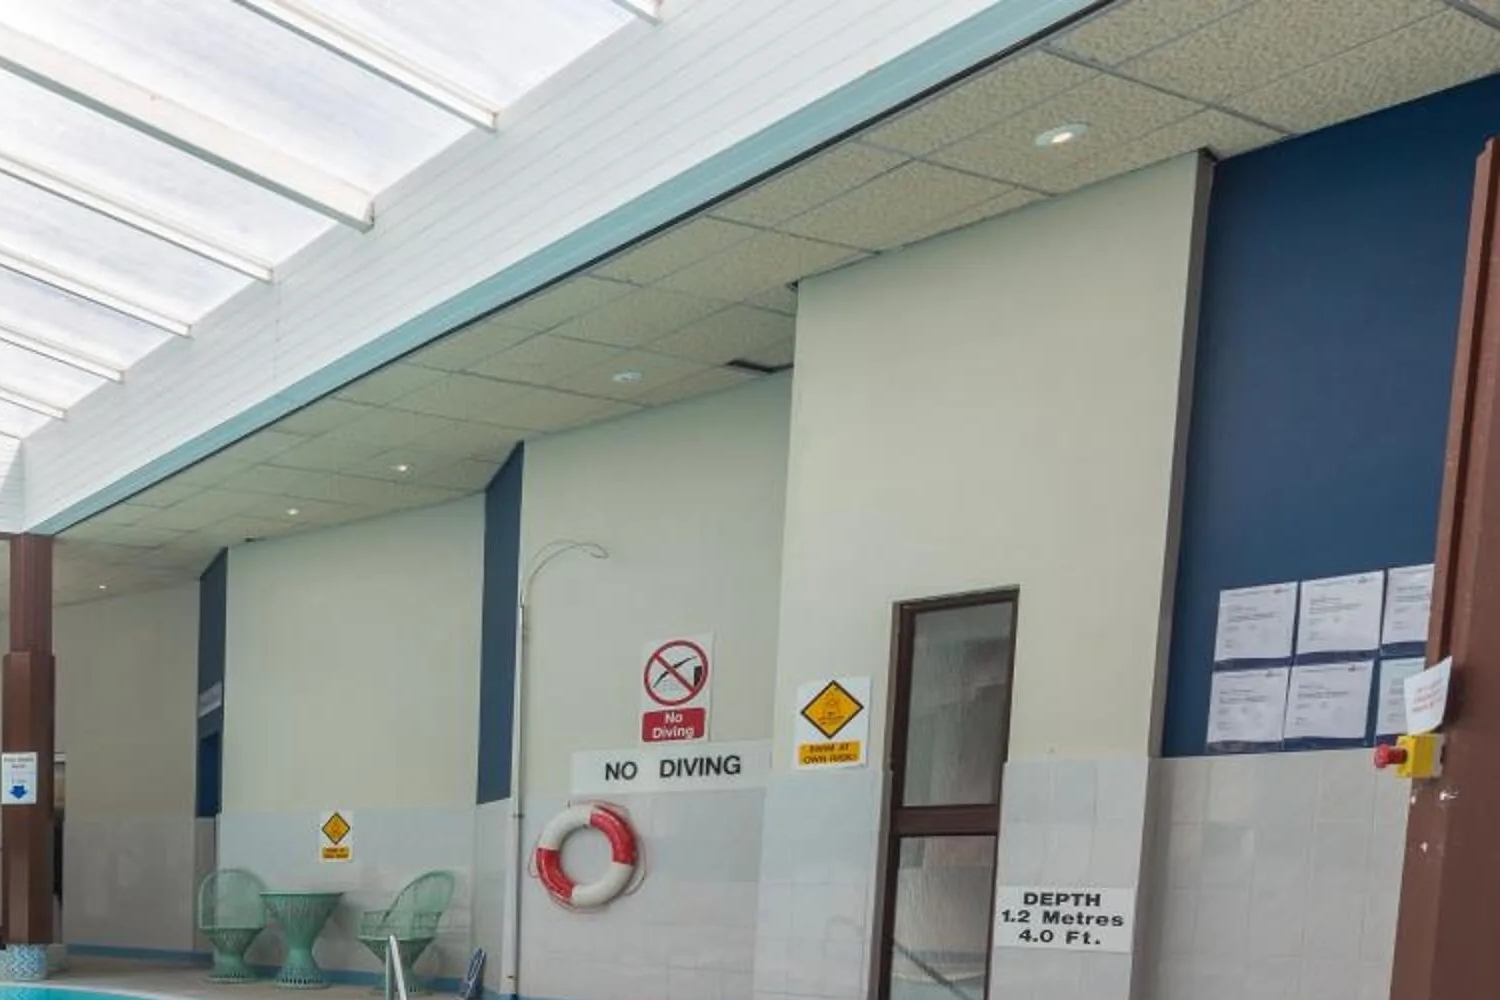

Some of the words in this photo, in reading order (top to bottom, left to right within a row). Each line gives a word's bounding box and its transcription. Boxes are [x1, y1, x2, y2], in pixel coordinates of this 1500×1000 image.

[665, 712, 683, 723] No
[652, 726, 694, 739] Diving
[605, 761, 638, 781] NO
[659, 755, 741, 778] DIVING
[1023, 892, 1101, 907] DEPTH
[1002, 909, 1030, 923] 1.2
[1042, 910, 1124, 927] Metres
[1019, 929, 1054, 943] 4.0
[1065, 930, 1101, 945] Ft.
